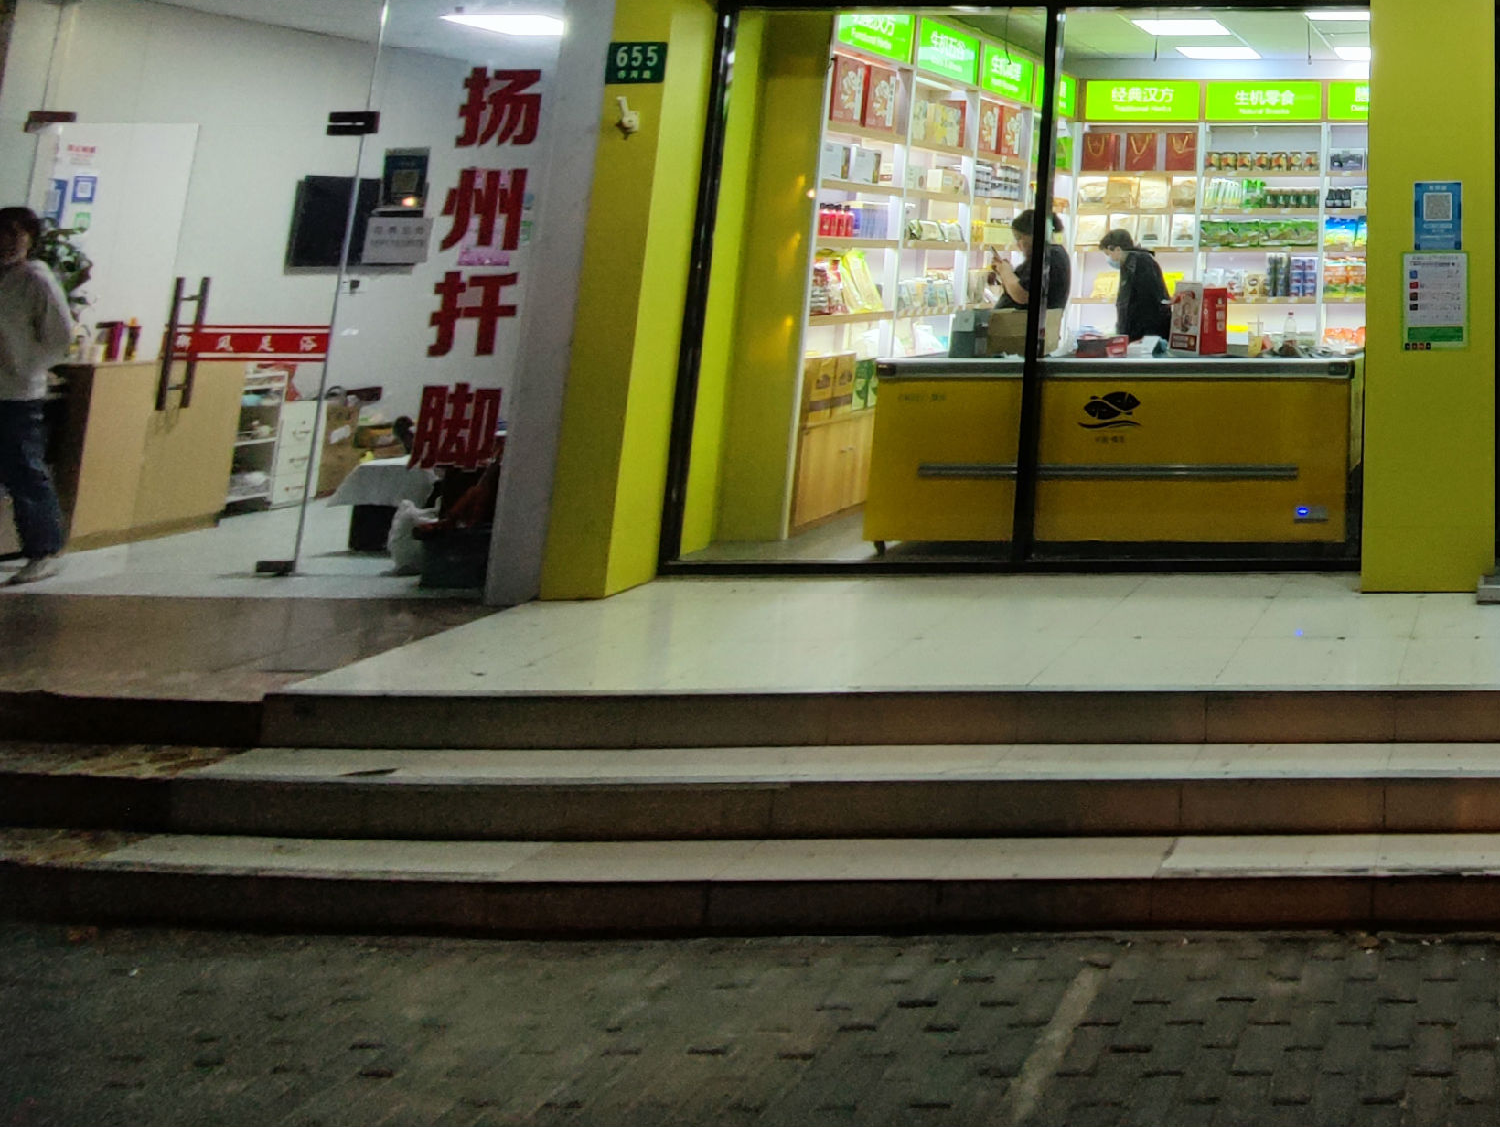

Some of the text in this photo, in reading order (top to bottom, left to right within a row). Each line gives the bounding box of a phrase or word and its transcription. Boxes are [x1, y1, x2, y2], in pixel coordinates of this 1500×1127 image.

[616, 46, 658, 67] 655
[1235, 89, 1295, 105] 生机零食
